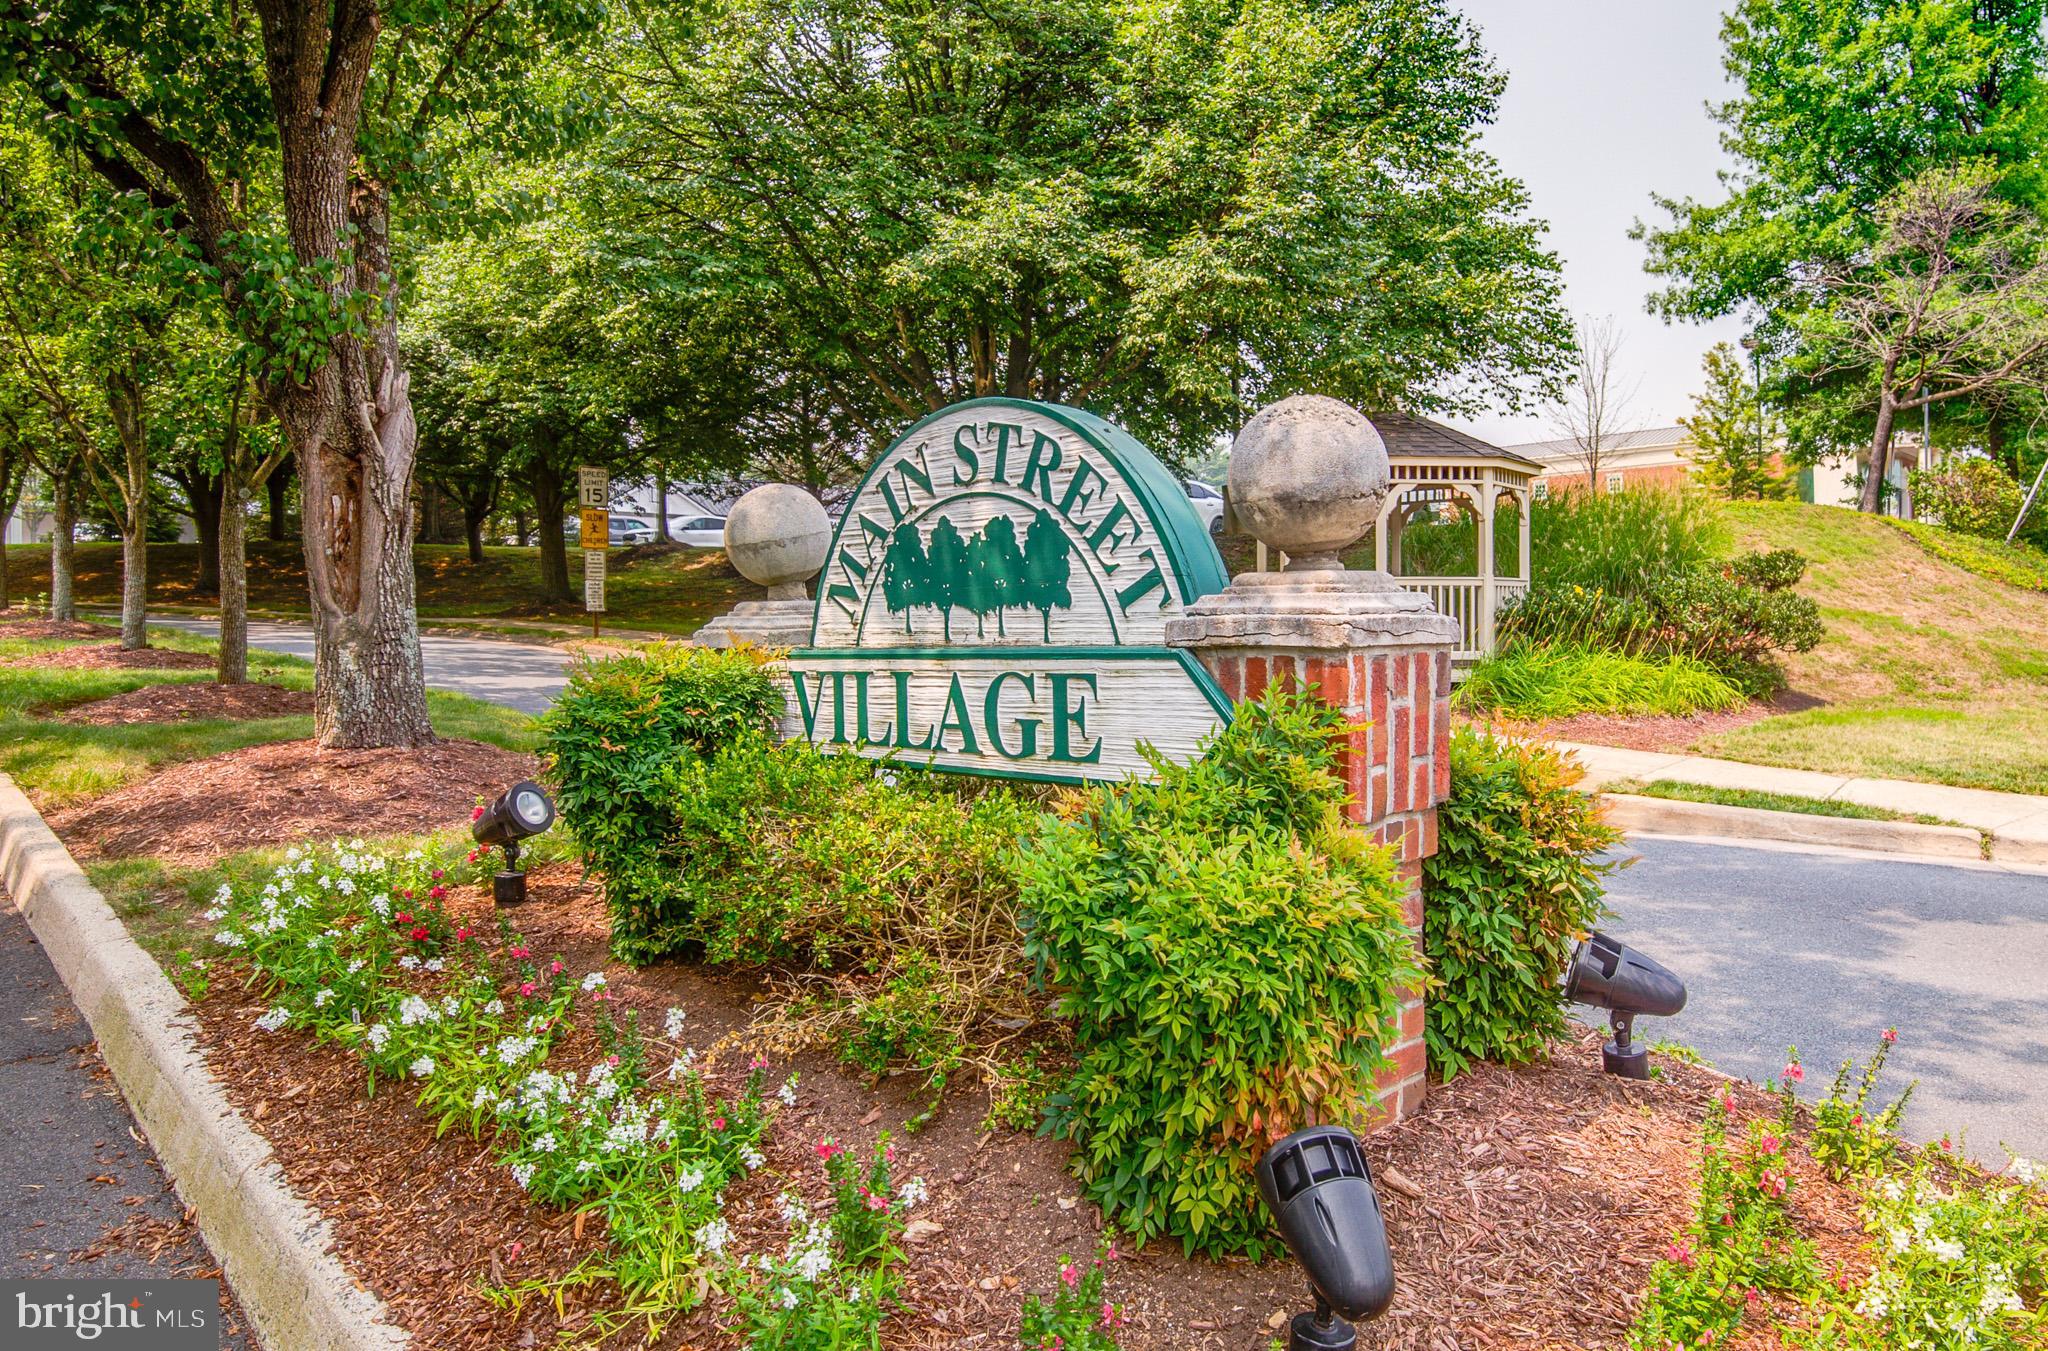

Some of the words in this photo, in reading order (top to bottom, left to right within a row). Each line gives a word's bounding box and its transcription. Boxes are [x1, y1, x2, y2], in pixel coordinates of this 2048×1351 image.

[582, 470, 606, 478] SPEED
[585, 488, 603, 503] 15
[586, 514, 604, 522] SLOW
[826, 441, 935, 626] MAIN
[953, 422, 1175, 618] STREET
[789, 671, 1102, 764] VILLAGE
